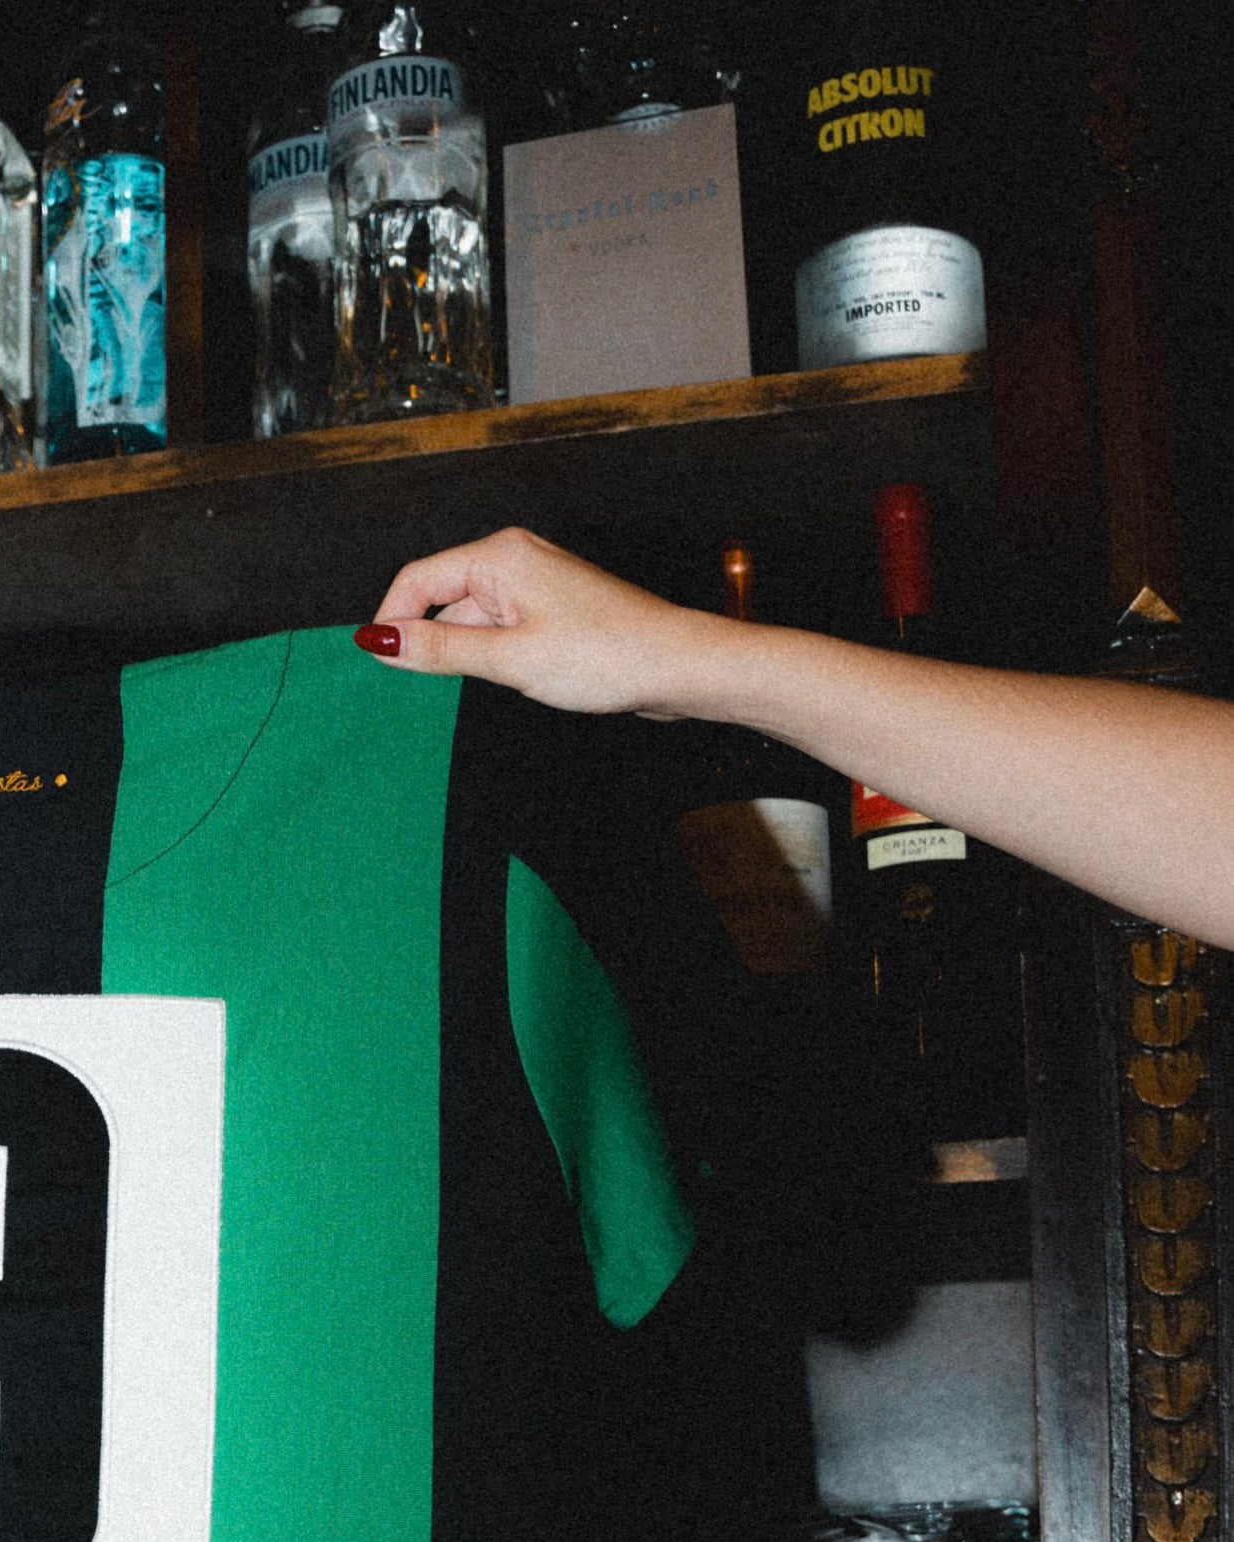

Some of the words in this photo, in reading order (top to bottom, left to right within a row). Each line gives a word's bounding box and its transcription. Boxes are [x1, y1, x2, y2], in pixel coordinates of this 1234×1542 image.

[331, 64, 453, 121] FINLANDIA
[808, 65, 934, 119] ABSOLUT
[818, 107, 926, 153] CITRON
[845, 299, 922, 323] IMPORTED
[882, 836, 947, 852] CRIANZA
